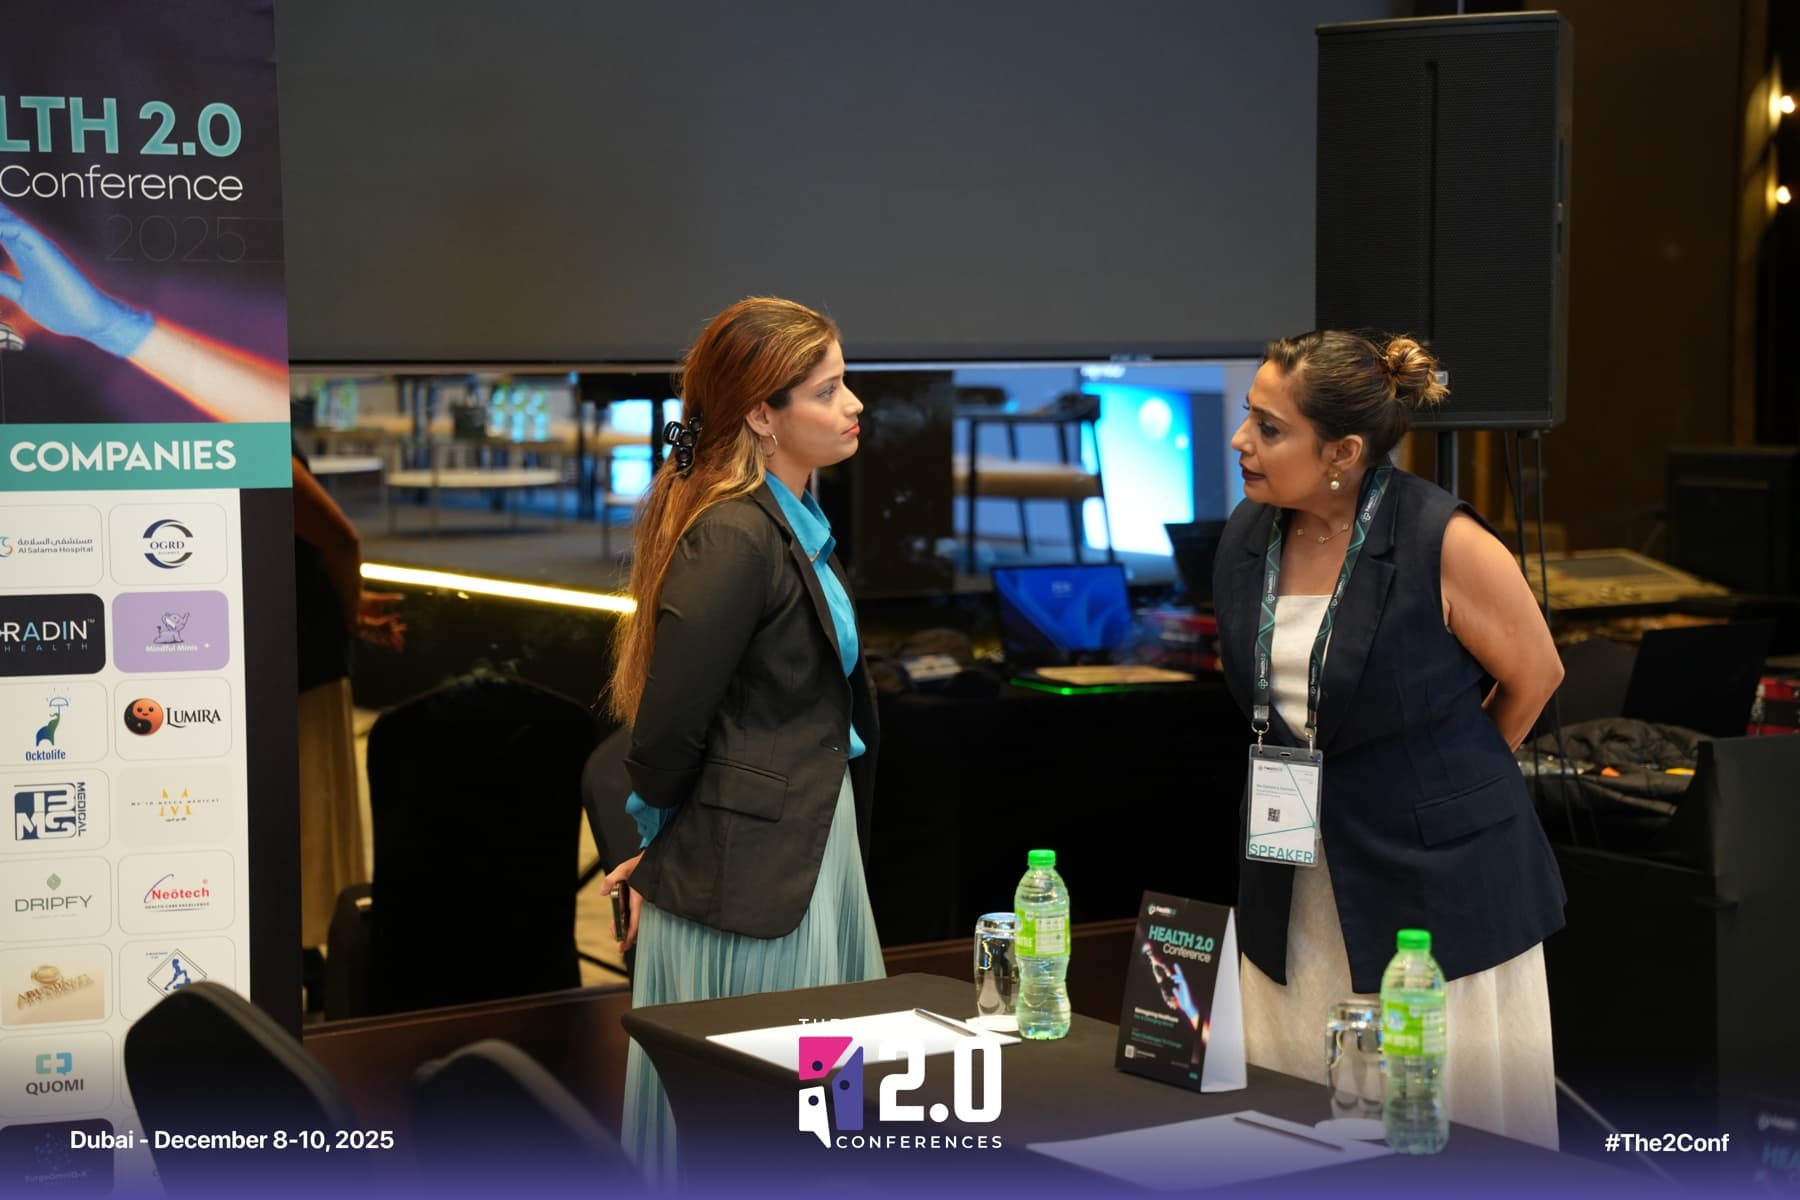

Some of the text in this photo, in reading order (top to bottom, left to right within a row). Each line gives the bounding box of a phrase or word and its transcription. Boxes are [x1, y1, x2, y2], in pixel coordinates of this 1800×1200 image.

[139, 100, 242, 157] 2.0
[0, 164, 244, 201] Conference
[104, 214, 247, 263] 2025
[10, 440, 237, 472] COMPANIES
[59, 545, 93, 554] Hospital
[150, 541, 185, 550] OGRD
[4, 641, 88, 652] HEALTH
[25, 749, 66, 761] Ocktolife
[77, 782, 87, 837] MEDICAL
[1249, 843, 1313, 864] SPEAKER
[15, 895, 93, 912] DRIPFY
[1148, 924, 1214, 953] HEALTH 2.0
[1162, 942, 1212, 963] Conference
[25, 1079, 84, 1096] QUOMI
